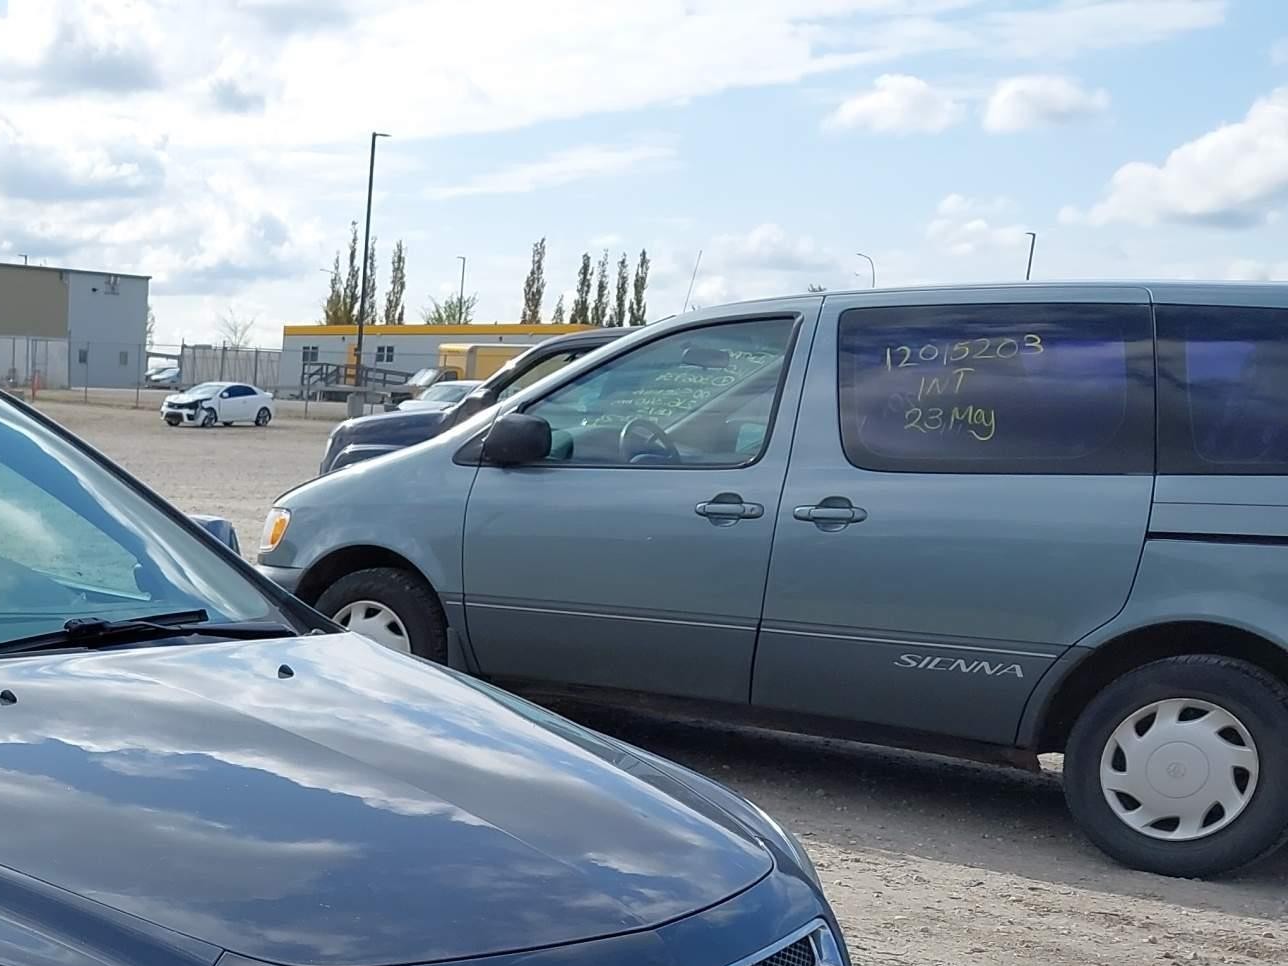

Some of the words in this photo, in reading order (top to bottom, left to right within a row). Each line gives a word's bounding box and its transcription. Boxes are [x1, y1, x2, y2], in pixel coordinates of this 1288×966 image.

[886, 334, 1044, 372] 12015203
[918, 367, 975, 401] INT
[904, 407, 944, 433] 23
[949, 405, 996, 441] May
[893, 653, 1024, 678] SIENNA
